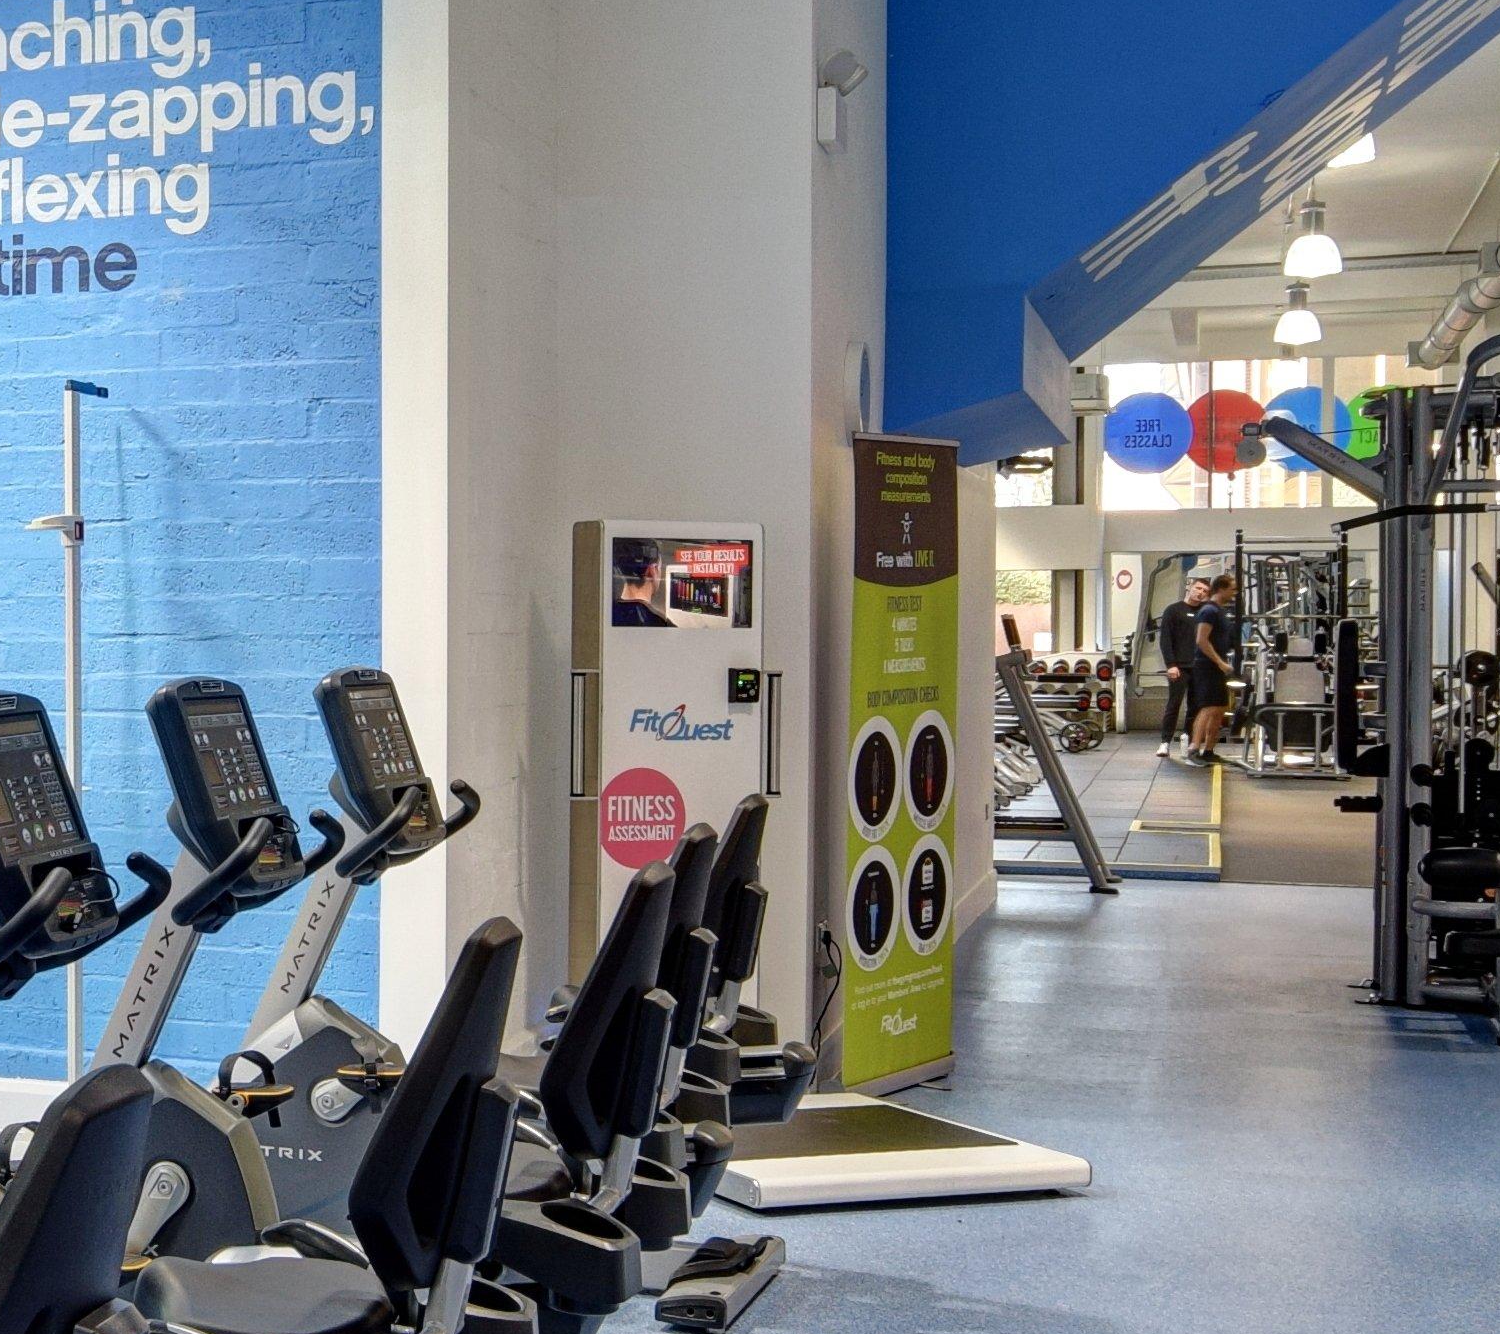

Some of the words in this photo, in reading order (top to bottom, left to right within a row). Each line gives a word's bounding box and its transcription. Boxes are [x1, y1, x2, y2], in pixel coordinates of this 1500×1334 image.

[876, 451, 902, 466] Fitness
[903, 452, 916, 467] and
[918, 454, 935, 472] body
[885, 471, 928, 487] composition
[881, 490, 931, 503] measurements
[680, 550, 693, 562] SEE
[694, 550, 712, 562] YOUR
[713, 548, 745, 562] RESULTS
[876, 551, 894, 568] Free
[896, 550, 913, 567] with
[629, 703, 734, 742] FitQuest
[608, 795, 676, 822] FITNESS
[608, 824, 676, 842] ASSESSMENT
[281, 879, 336, 995] MATRIX
[113, 925, 175, 1058] MATRIX
[260, 1144, 324, 1163] TRIX
